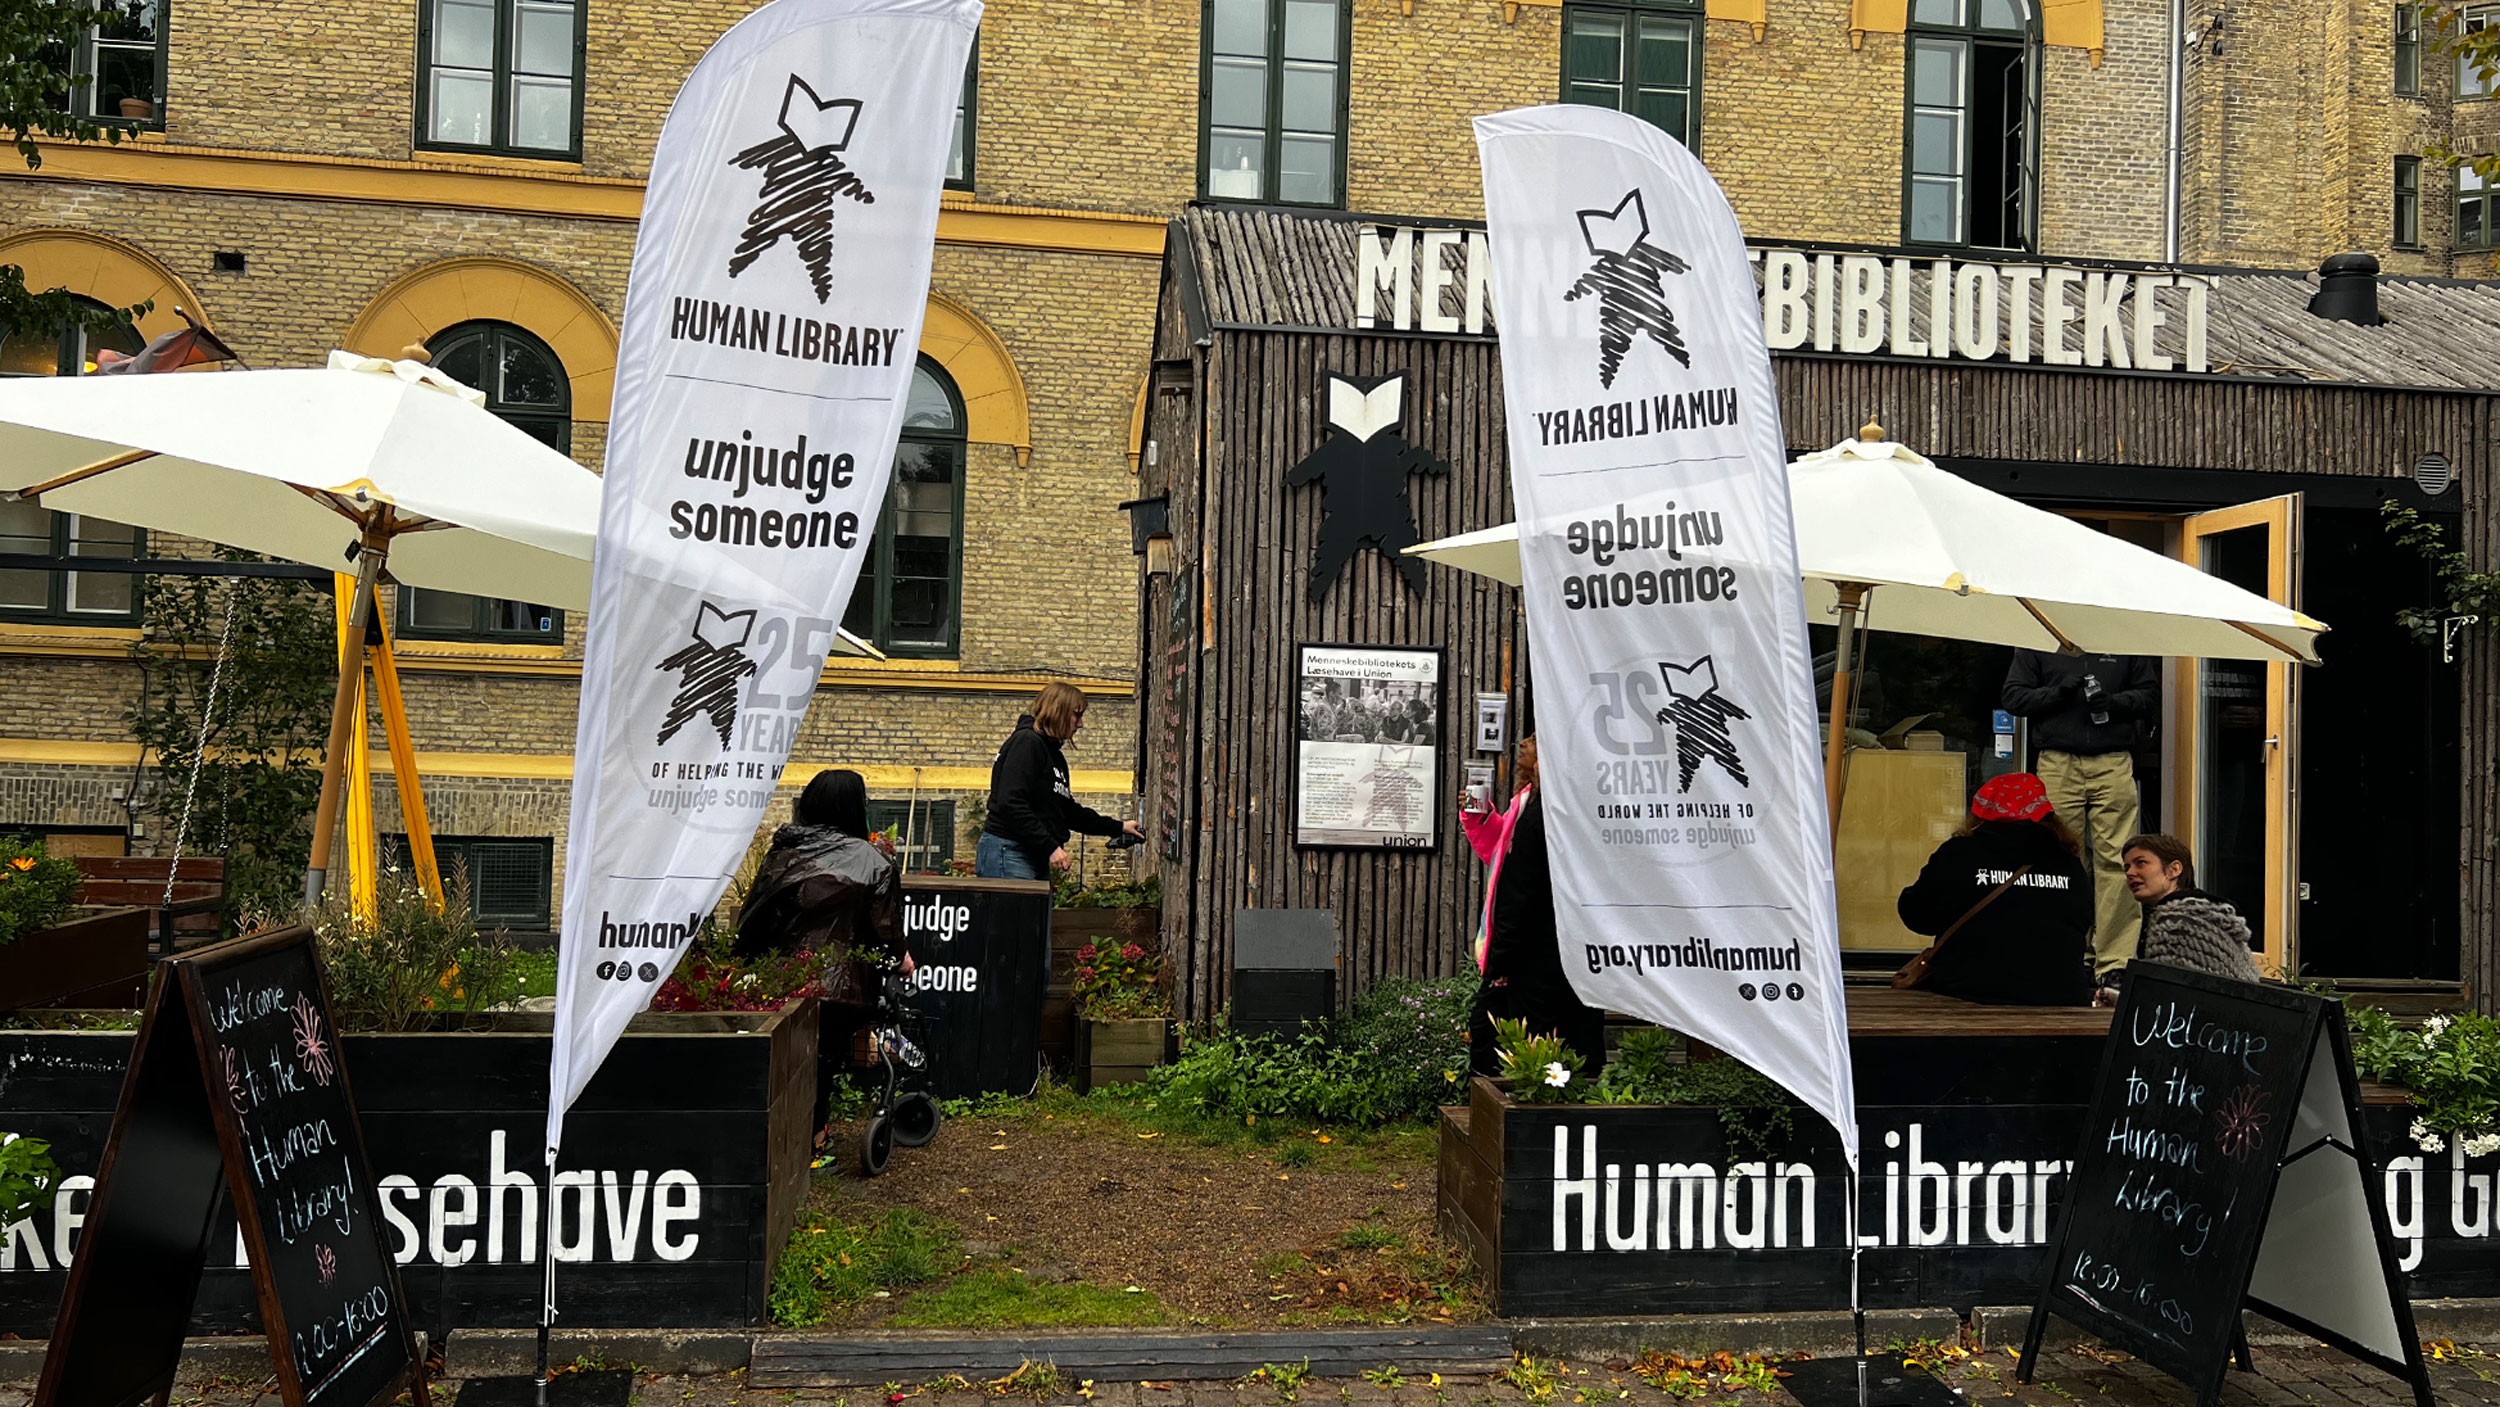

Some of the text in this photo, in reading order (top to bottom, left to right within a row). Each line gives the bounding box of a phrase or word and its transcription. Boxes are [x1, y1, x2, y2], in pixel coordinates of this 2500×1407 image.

[671, 297, 899, 367] HUMAN LIBRARY
[684, 429, 855, 501] unjudge
[669, 500, 859, 549] someone
[745, 617, 833, 711] 25
[1307, 655, 1416, 670] Menneskebibliotekets
[1307, 666, 1355, 677] Læsehave
[1363, 668, 1392, 678] Union
[739, 714, 800, 754] YEAR
[652, 762, 669, 778] OF
[678, 762, 729, 780] HELPING
[737, 762, 764, 779] THE
[1383, 834, 1427, 847] union
[2029, 873, 2069, 890] LIBRARY
[903, 894, 970, 941] judge
[207, 978, 288, 1033] Welcome
[2133, 1002, 2267, 1077] Welcome
[243, 1043, 304, 1107] to the
[2126, 1066, 2205, 1116] to the
[246, 1119, 337, 1188] Human
[2107, 1116, 2203, 1174] Human
[276, 1154, 359, 1244] Library!
[378, 1129, 702, 1267] sehave
[1553, 1123, 2075, 1252] Human Librar
